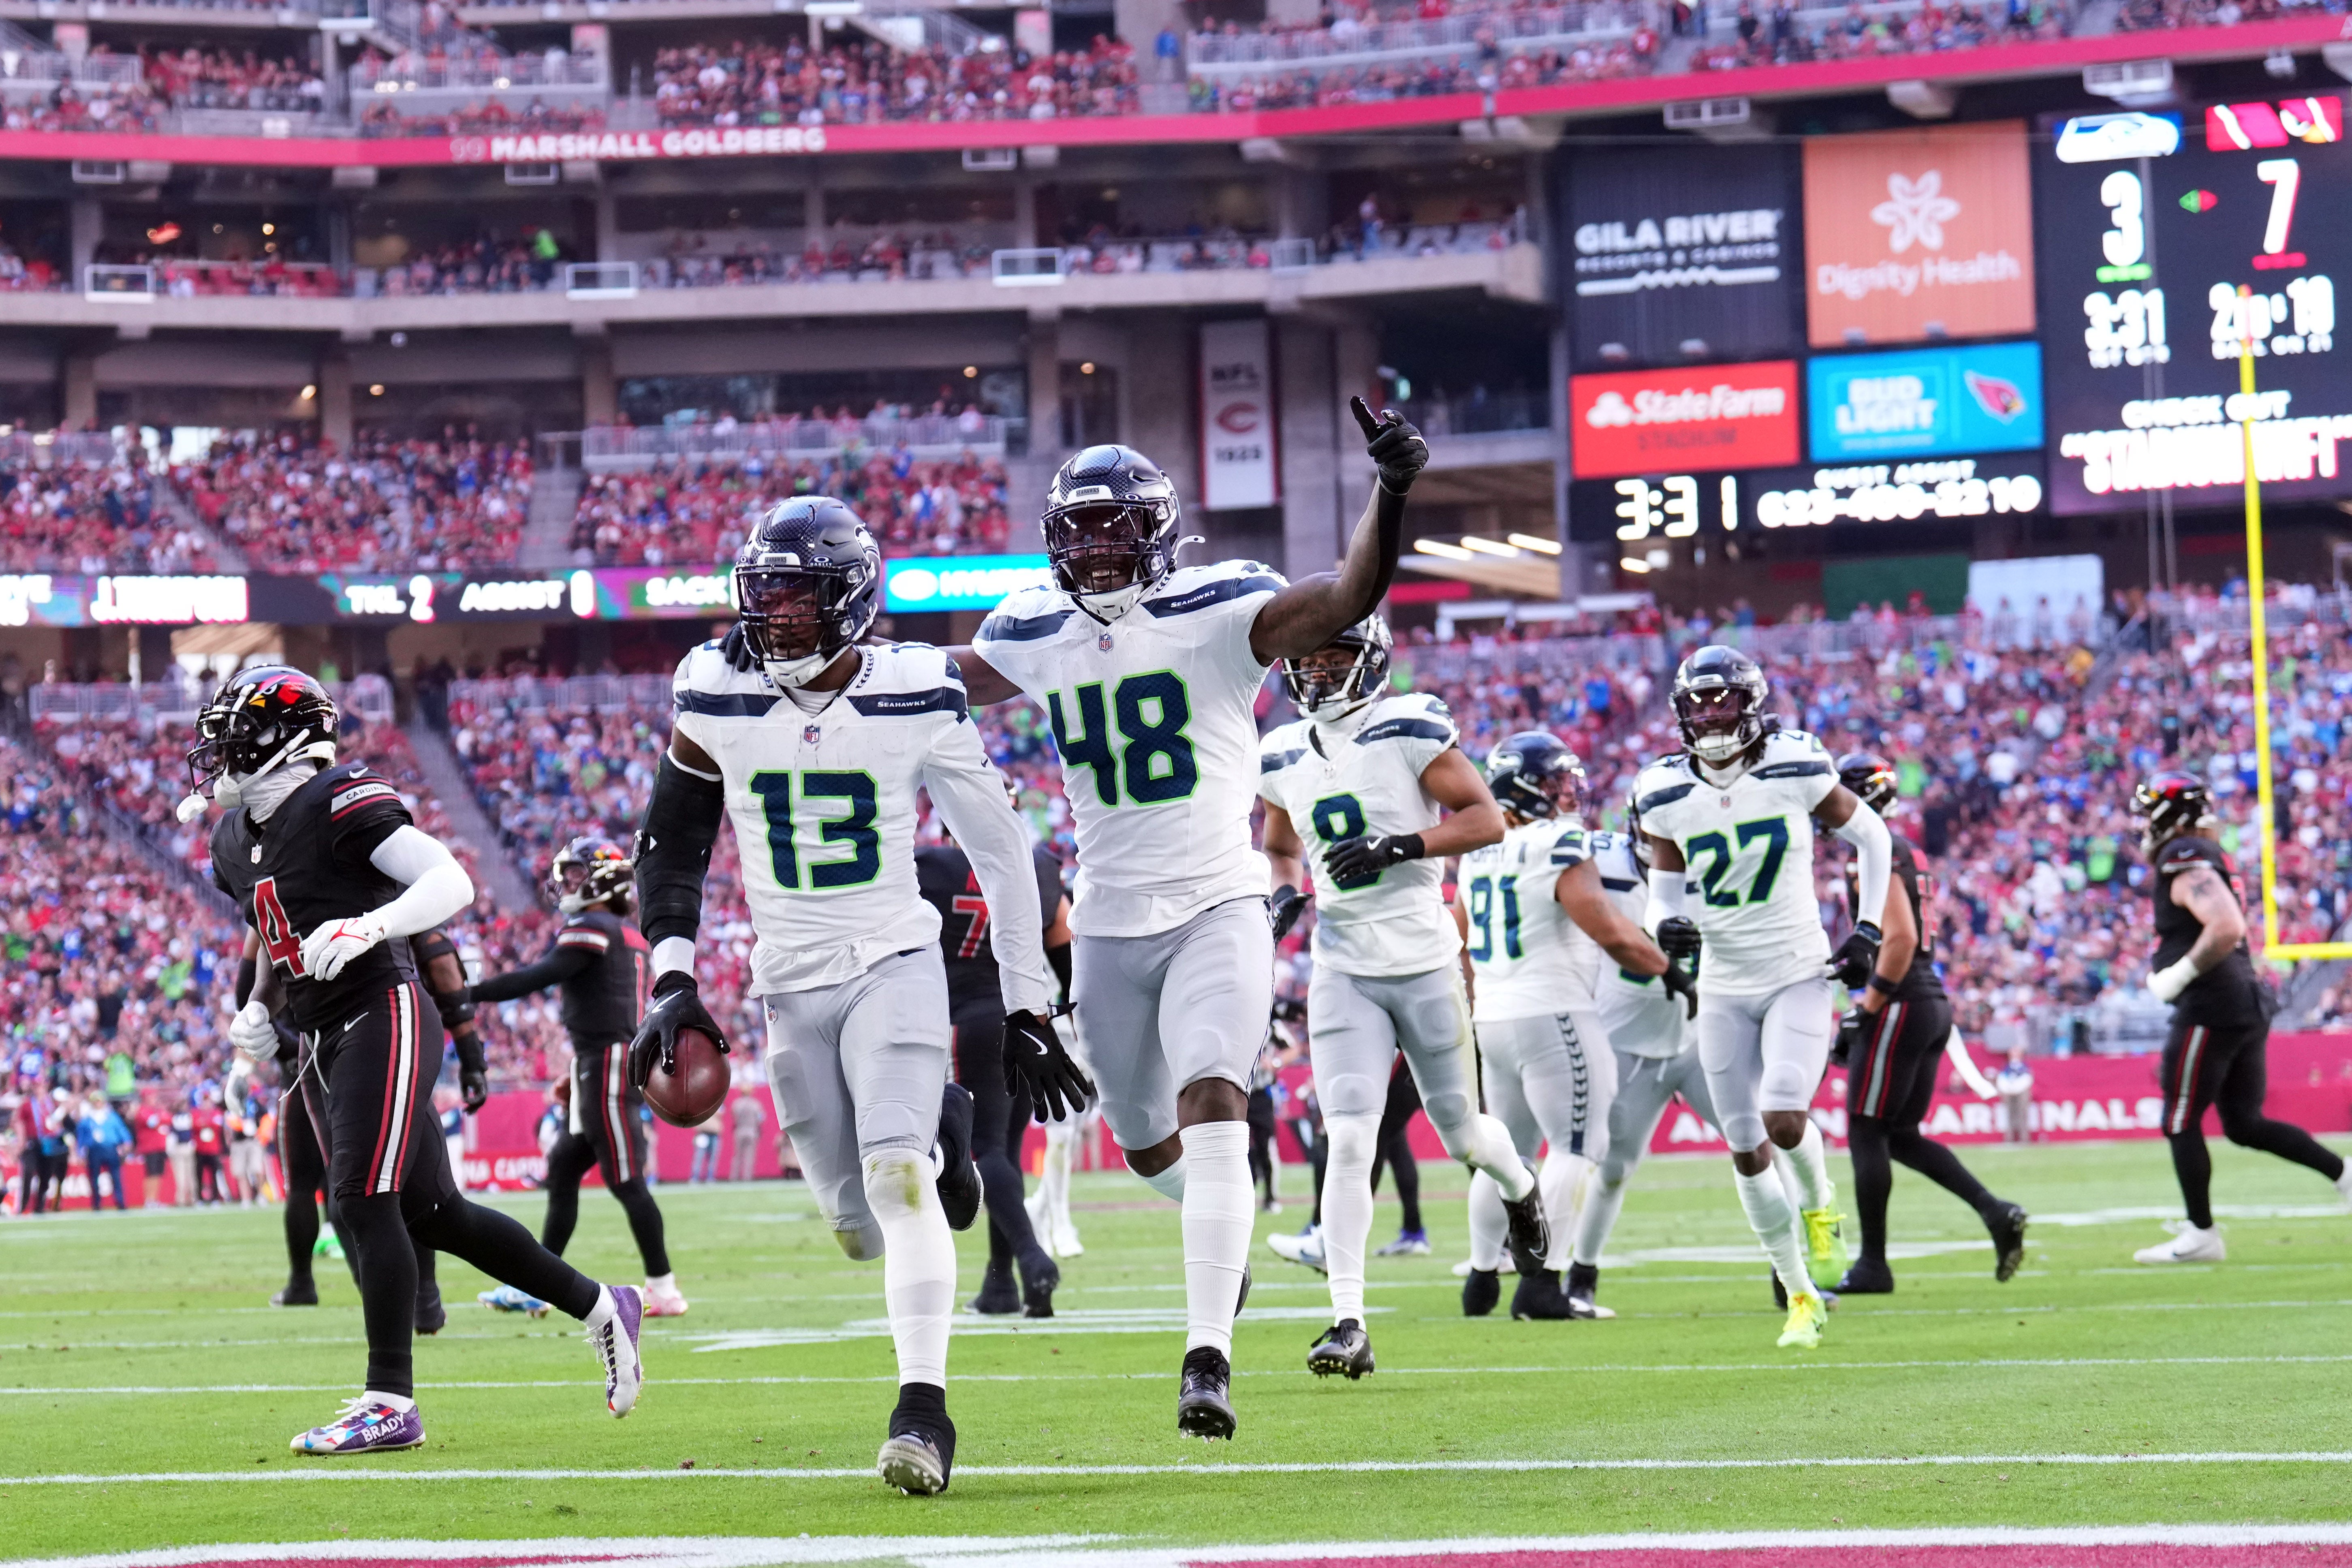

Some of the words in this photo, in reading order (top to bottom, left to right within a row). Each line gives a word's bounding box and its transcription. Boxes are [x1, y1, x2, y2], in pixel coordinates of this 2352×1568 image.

[491, 132, 656, 161] MARSHALL
[662, 127, 827, 158] GOLDBERG
[1575, 218, 1662, 254] GILA
[1664, 208, 1779, 246] RIVER
[2101, 171, 2145, 267] 3
[2257, 158, 2301, 254] 7
[1817, 259, 1920, 301] Dignity
[1922, 249, 2021, 287] Health
[1848, 375, 1924, 403] BUD
[1835, 398, 1938, 434] LIGHT
[1076, 487, 1100, 497] SEAHAWKS
[409, 574, 436, 623] 2
[645, 575, 730, 606] SACK
[1171, 590, 1216, 608] SEAHAWKS
[1045, 669, 1201, 808] 48
[748, 769, 883, 891] 13
[1311, 790, 1386, 893] 8
[1685, 814, 1791, 908] 27
[254, 876, 305, 979] 4
[1468, 874, 1524, 962] 91
[361, 1413, 405, 1443] BRADY
